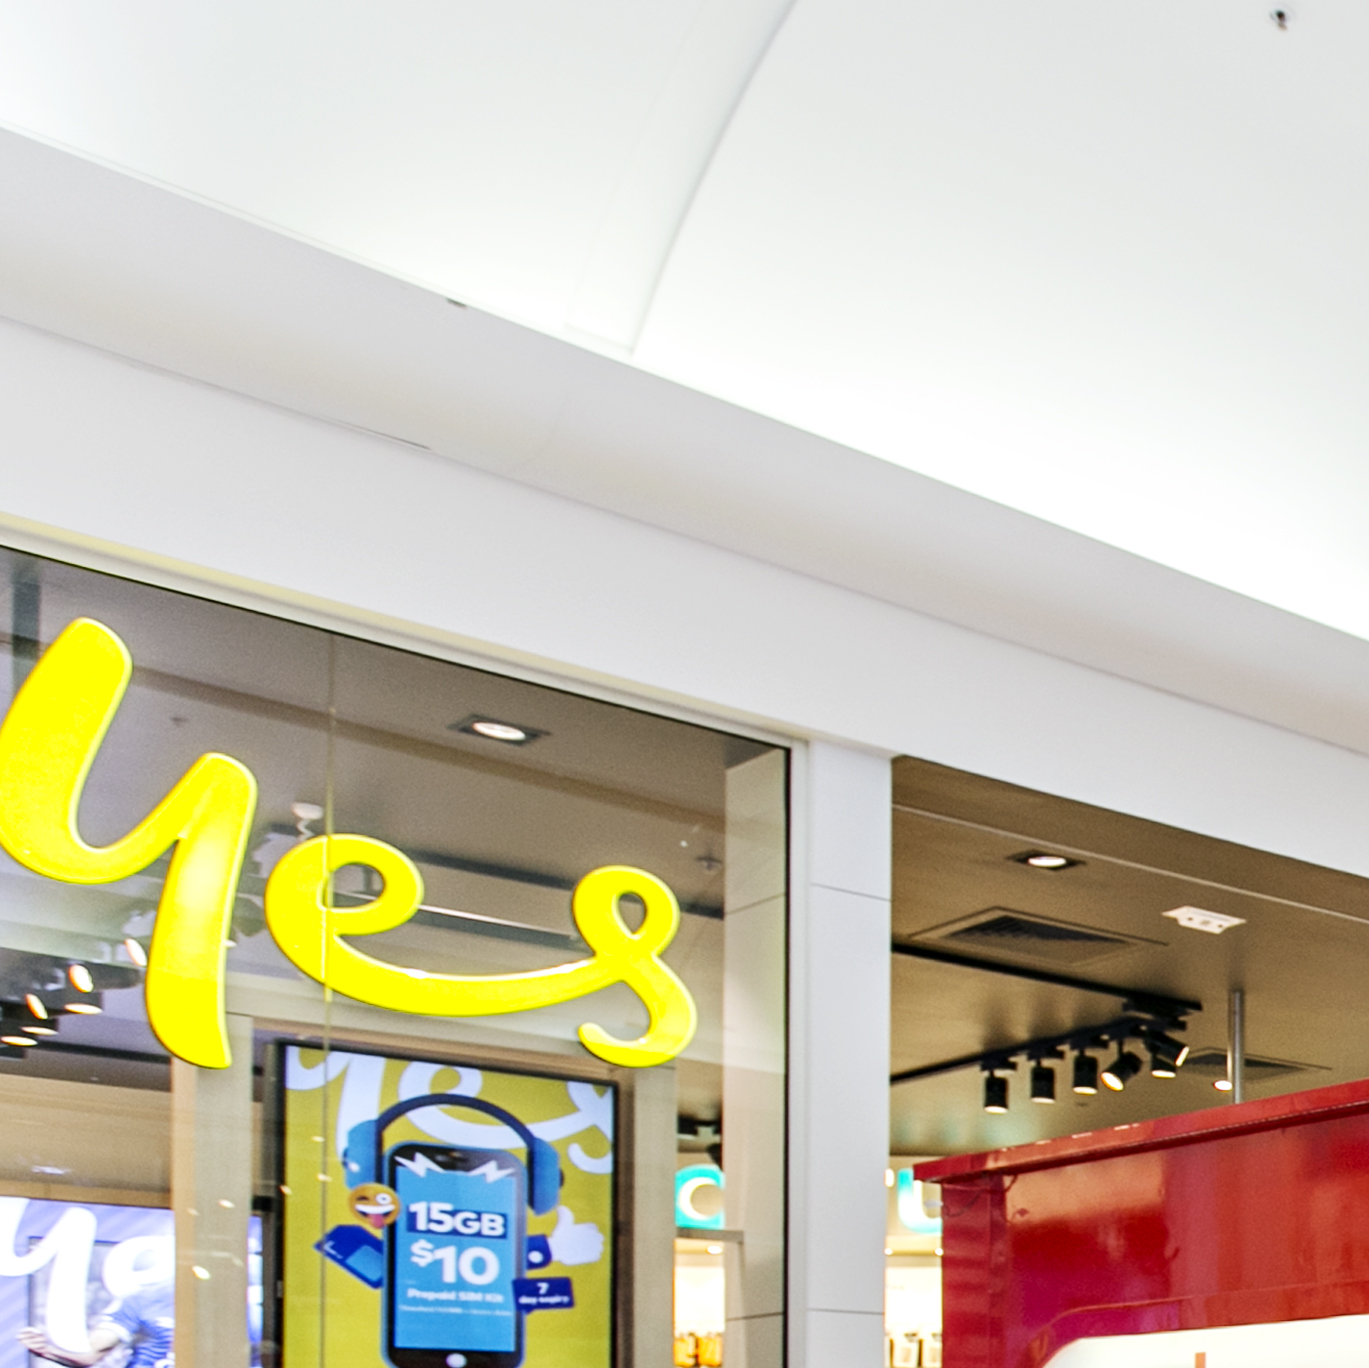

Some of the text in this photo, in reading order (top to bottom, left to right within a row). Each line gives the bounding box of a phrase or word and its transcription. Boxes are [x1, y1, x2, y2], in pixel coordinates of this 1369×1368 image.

[0, 617, 697, 1069] yes
[408, 1201, 505, 1237] 15GB
[410, 1239, 499, 1285] $10
[537, 1282, 549, 1294] 7
